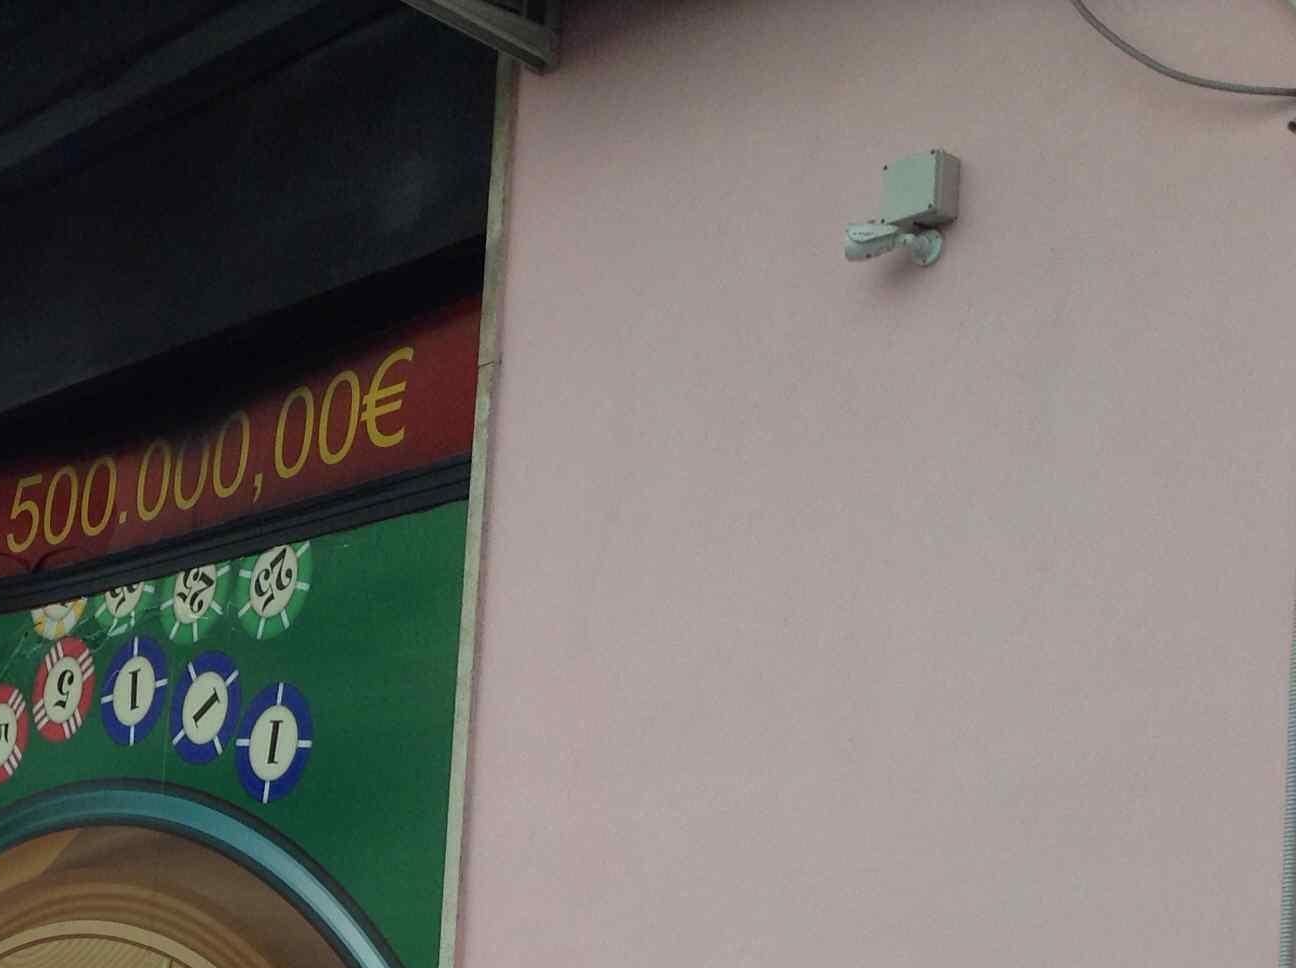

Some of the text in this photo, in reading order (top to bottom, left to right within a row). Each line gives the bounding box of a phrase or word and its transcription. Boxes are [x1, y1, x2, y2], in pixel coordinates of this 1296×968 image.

[5, 346, 414, 553] 500.000,00€
[56, 669, 74, 709] 5
[128, 668, 141, 711] 1
[266, 719, 283, 765] 1
